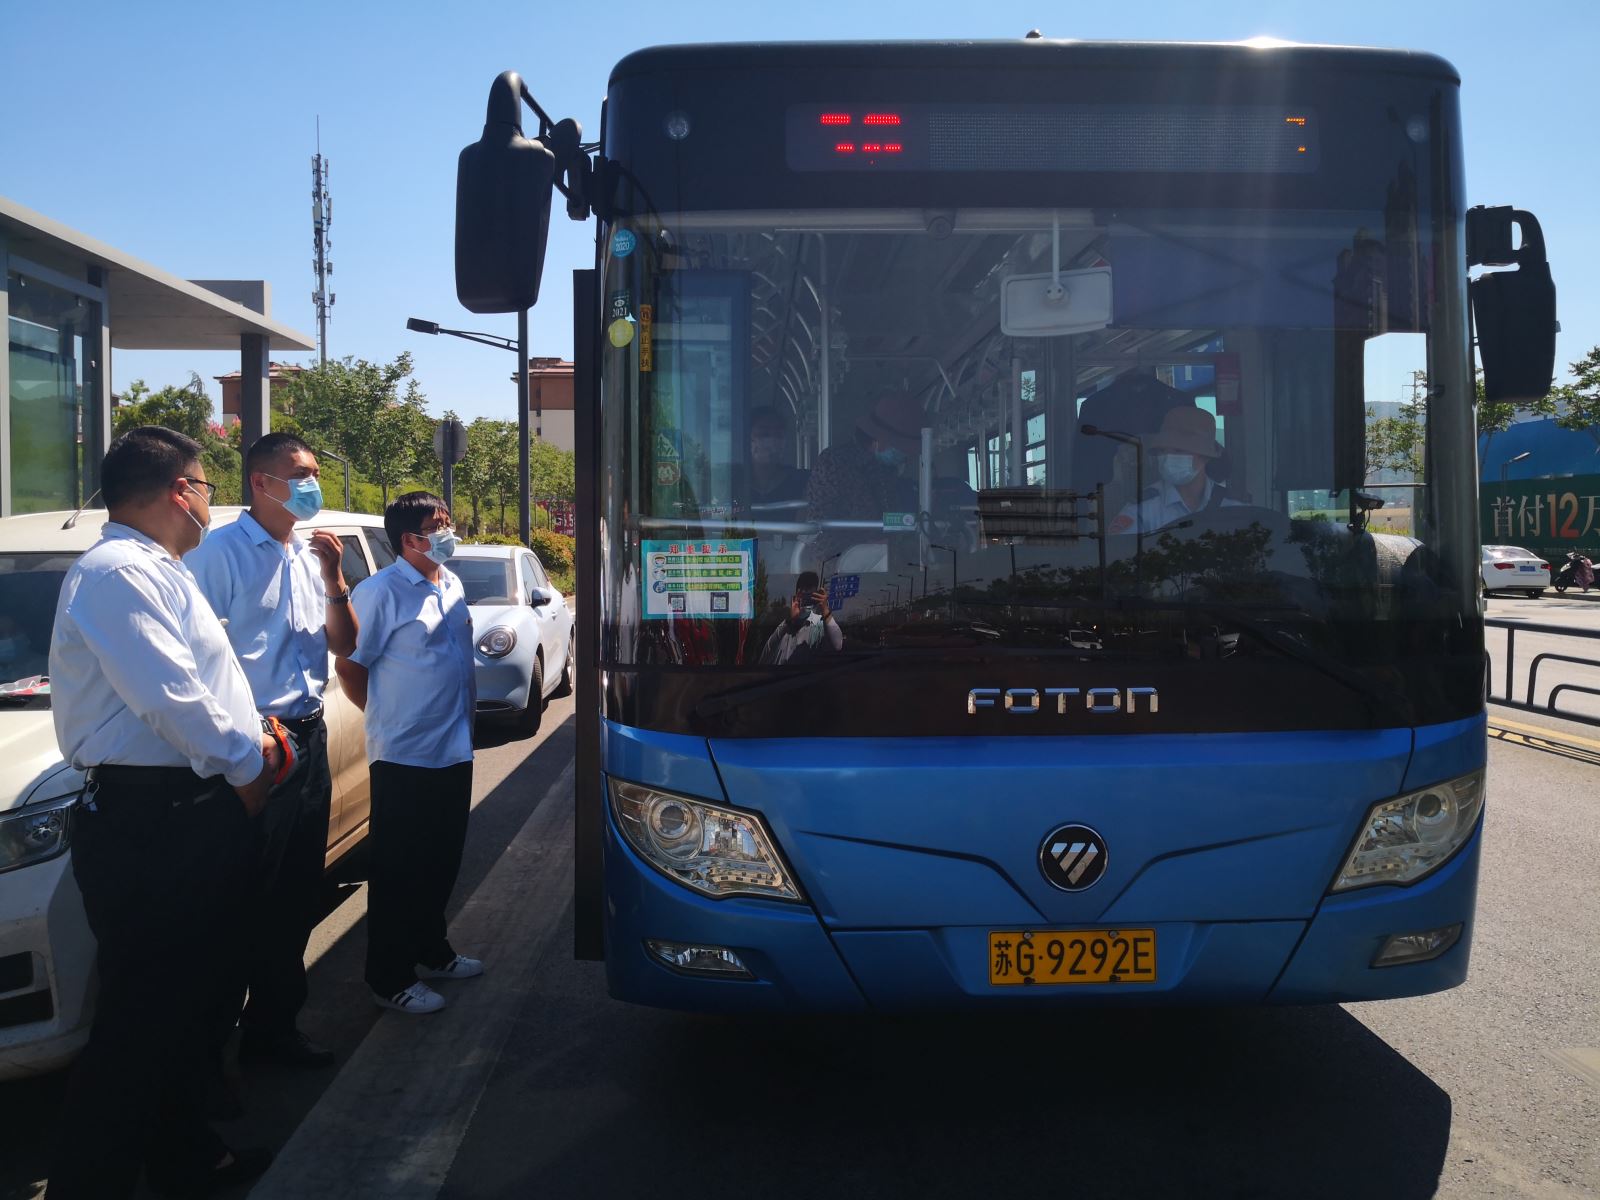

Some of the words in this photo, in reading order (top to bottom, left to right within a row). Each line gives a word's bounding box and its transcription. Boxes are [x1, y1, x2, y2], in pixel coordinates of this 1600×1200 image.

[612, 307, 627, 318] 2021
[1490, 492, 1600, 538] 首付12万
[967, 688, 1158, 714] FOTON
